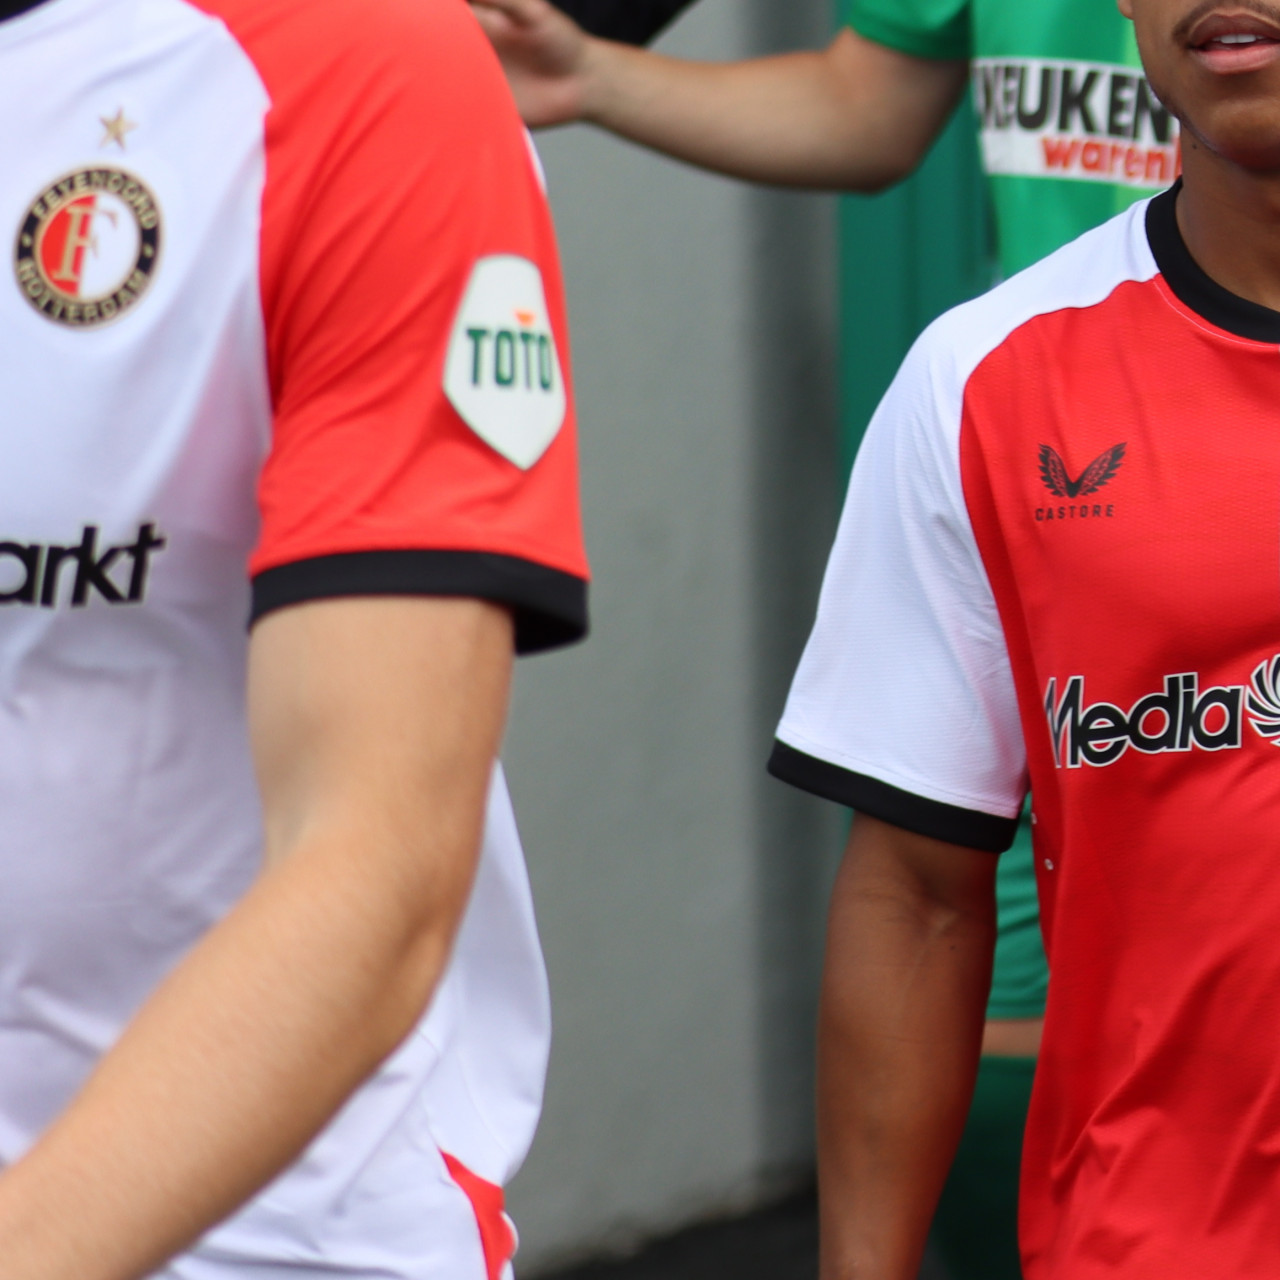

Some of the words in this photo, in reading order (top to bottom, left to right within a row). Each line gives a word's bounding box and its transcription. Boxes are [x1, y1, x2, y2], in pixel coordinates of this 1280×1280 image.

[32, 169, 158, 230] FEYENOORD
[465, 327, 554, 394] TOTO
[1034, 503, 1115, 522] CASTORE
[1044, 670, 1244, 770] Media
